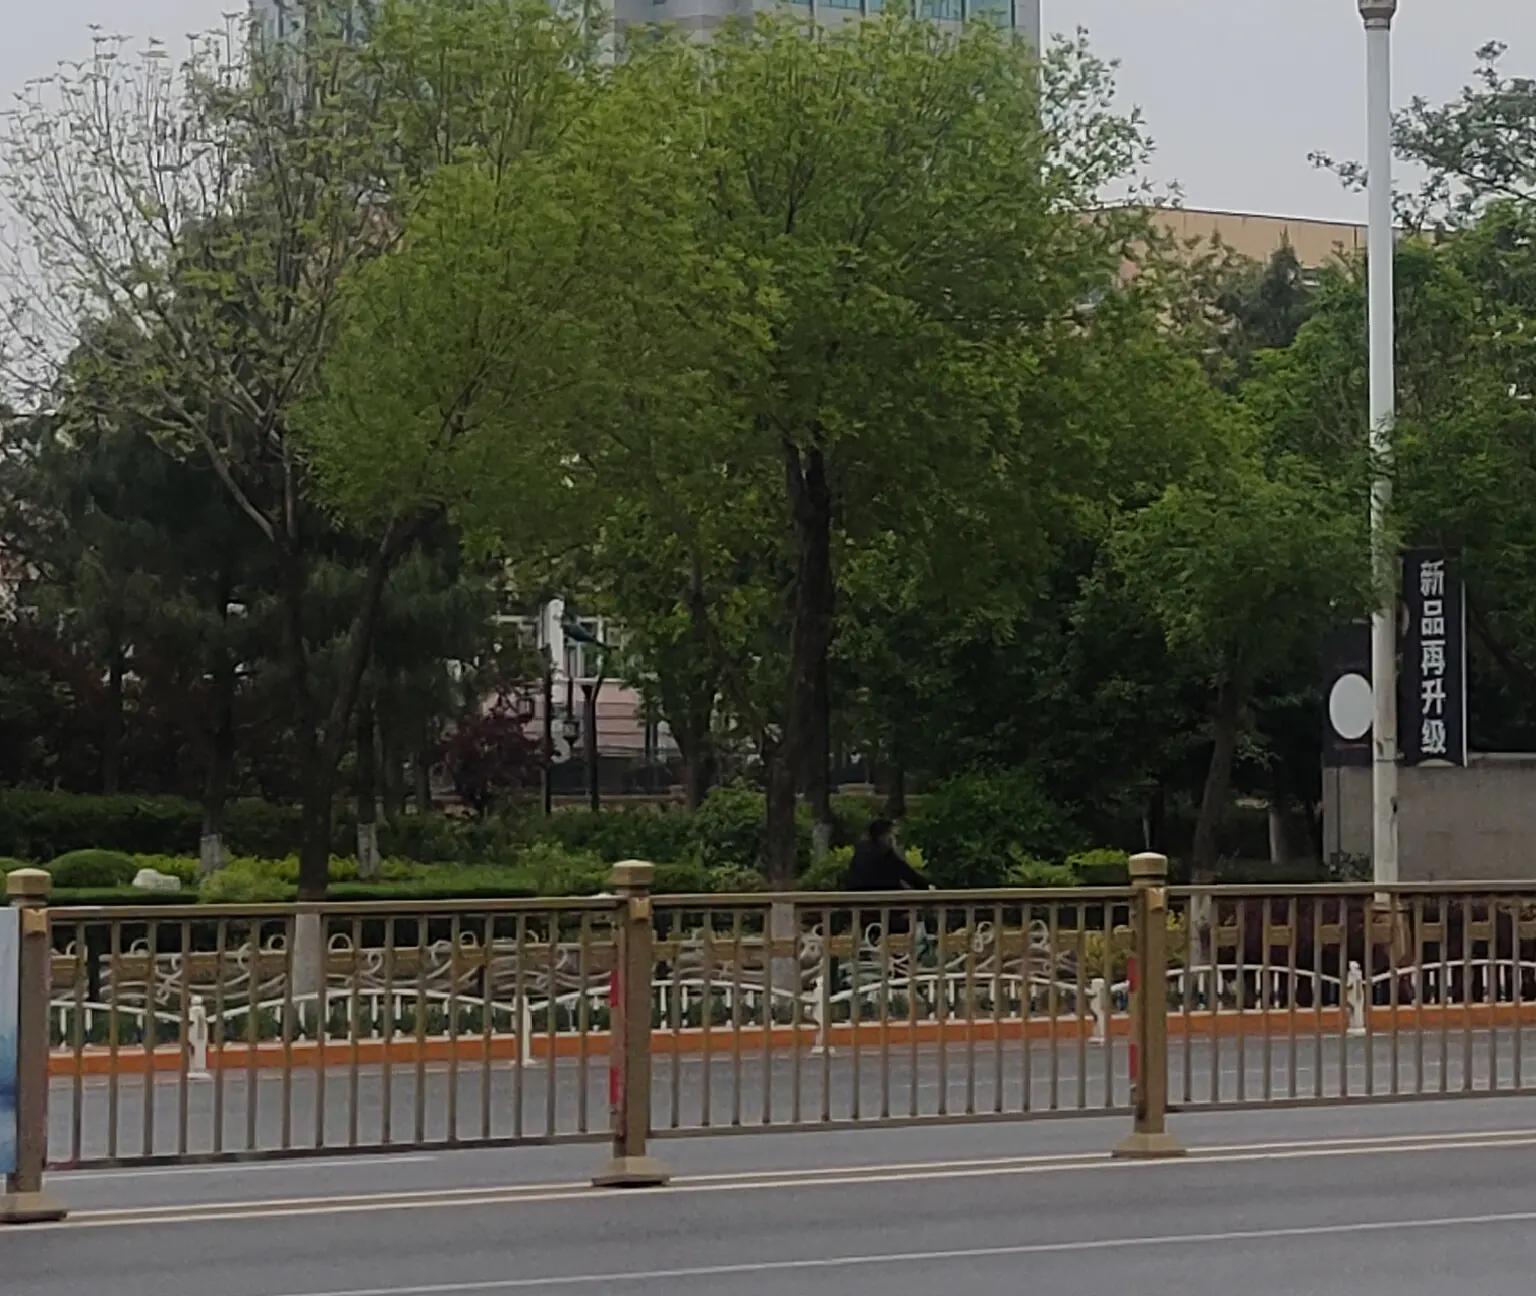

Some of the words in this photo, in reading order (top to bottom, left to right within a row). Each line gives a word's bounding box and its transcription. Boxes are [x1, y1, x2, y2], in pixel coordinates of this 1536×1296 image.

[1420, 560, 1447, 754] 新品再升级
